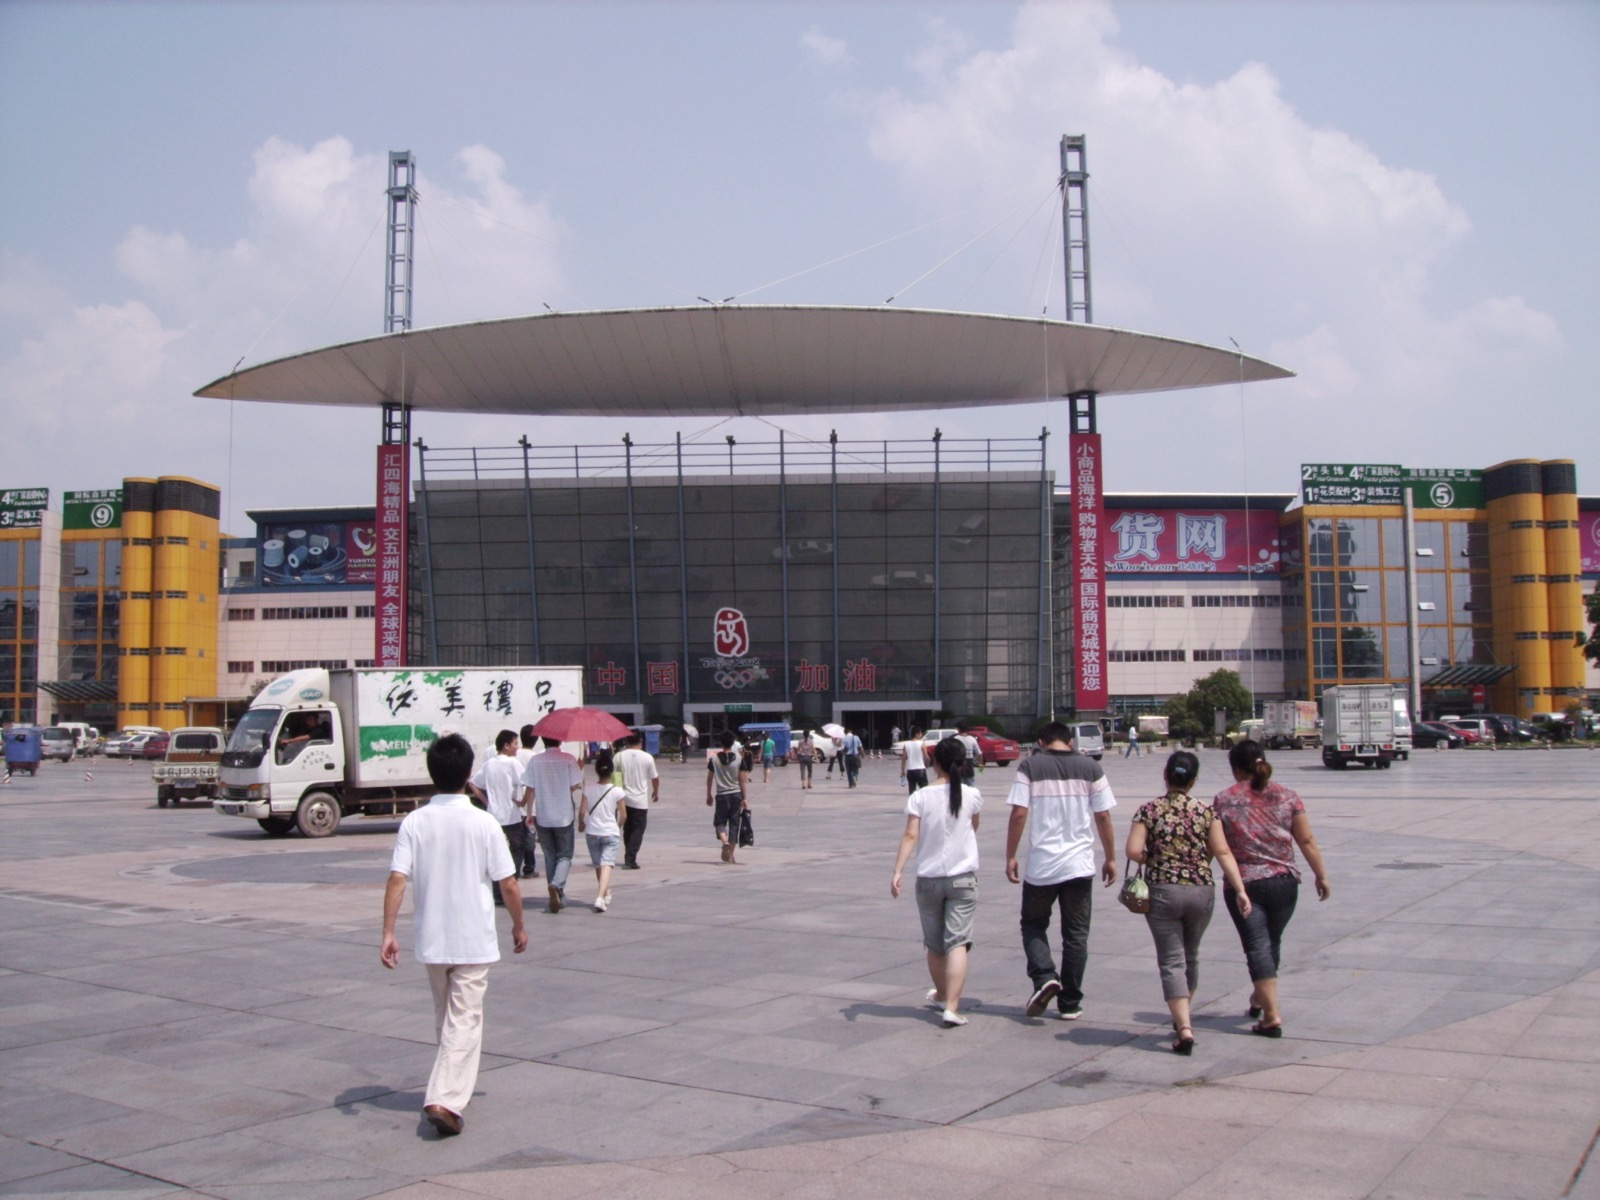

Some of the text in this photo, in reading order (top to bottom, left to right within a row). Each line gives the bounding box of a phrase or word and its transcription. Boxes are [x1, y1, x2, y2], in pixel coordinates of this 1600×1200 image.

[1302, 465, 1312, 480] 2
[1349, 466, 1359, 480] 4
[383, 454, 401, 523] 汇四海精品
[1305, 487, 1312, 501] 1
[1352, 487, 1360, 501] 3
[1436, 487, 1449, 504] 5
[1, 492, 10, 505] 4
[1, 511, 10, 525] 3
[96, 508, 110, 524] 9
[1111, 512, 1227, 561] 货网
[382, 527, 400, 598] 交五洲朋友
[1077, 443, 1101, 691] 小商品海洋 购物者天堂 国际商贸城欢迎您
[598, 658, 877, 695] 中国 加油
